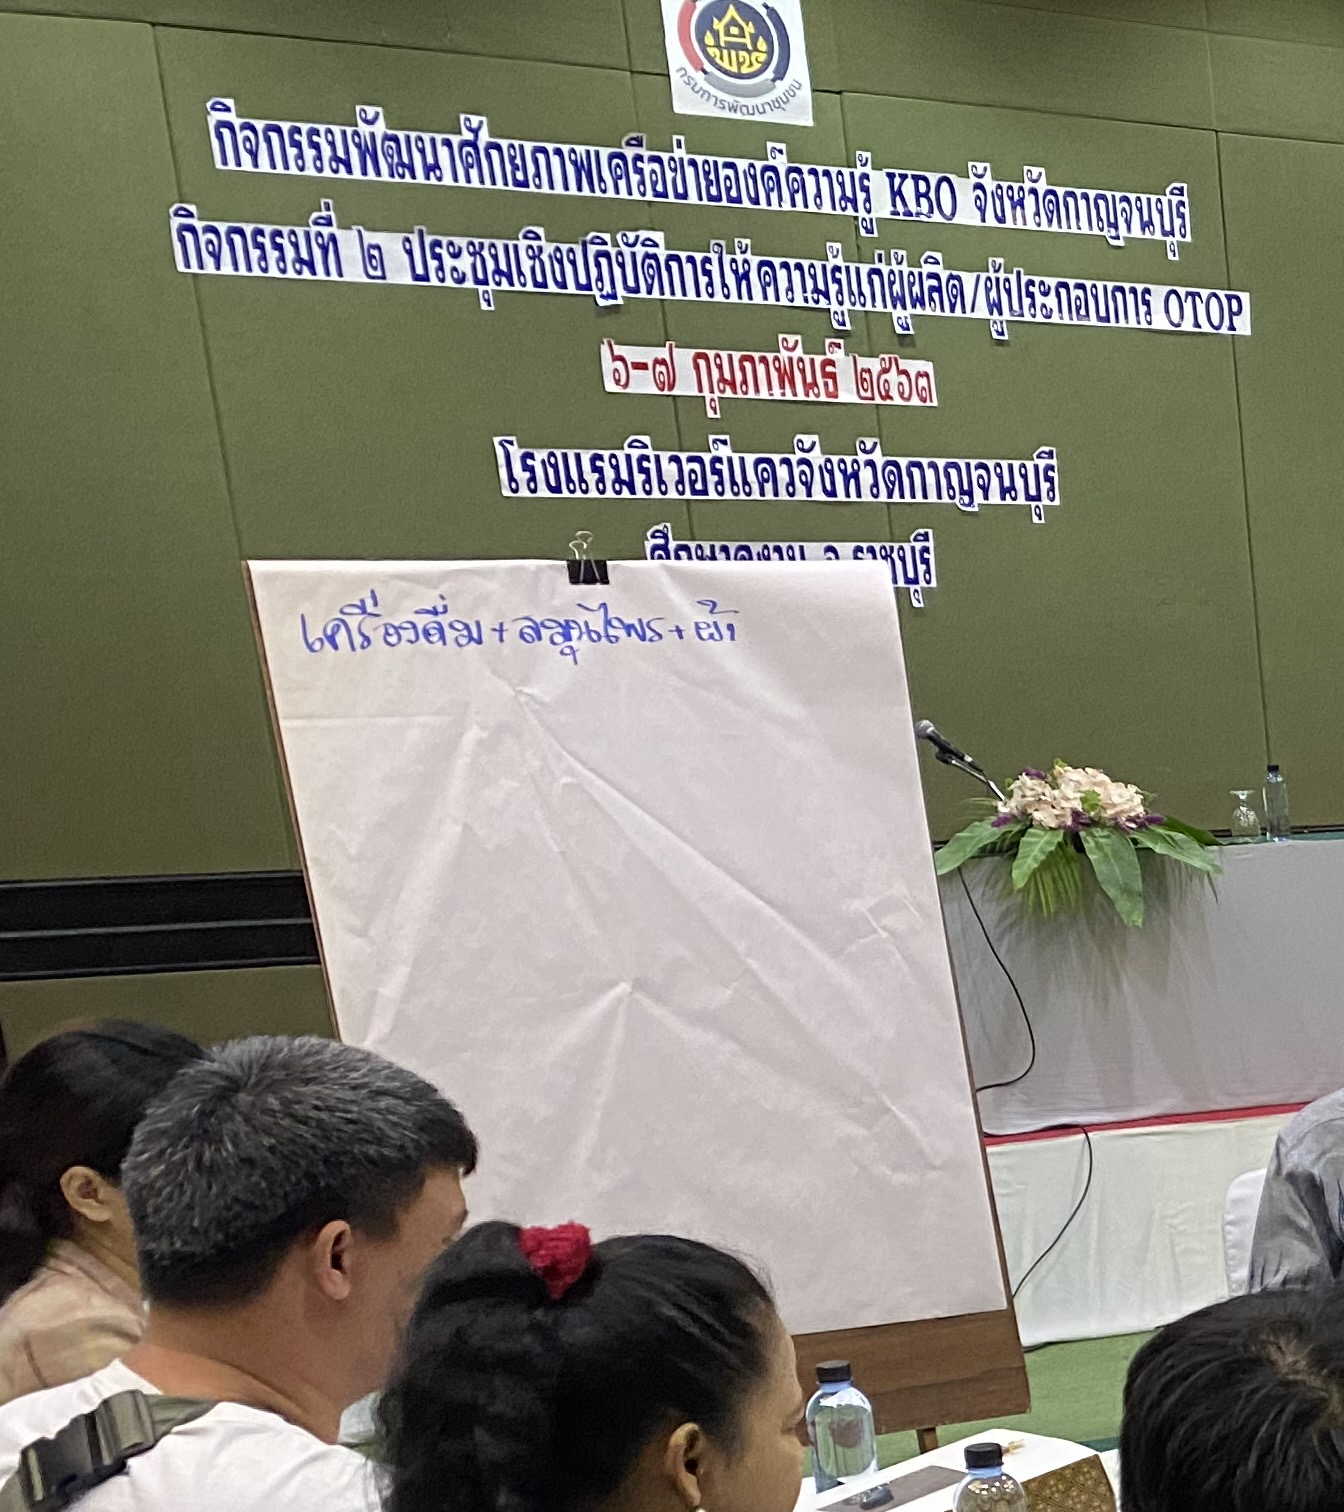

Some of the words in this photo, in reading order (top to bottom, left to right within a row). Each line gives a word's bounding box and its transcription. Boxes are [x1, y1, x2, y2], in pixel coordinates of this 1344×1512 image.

[885, 170, 958, 221] KBO
[972, 161, 1188, 259] จังหวัดกาญจนบุรี
[171, 200, 345, 280] กิจกรรมที่
[357, 229, 388, 281] ๒
[1163, 288, 1244, 332] OTOP
[691, 336, 841, 416] กุมภาพันธ์
[852, 354, 935, 404] ๒๕๖๓
[496, 438, 1058, 521] โรงแรมริเวอร์แควจังหวัดกาญจนบุรี
